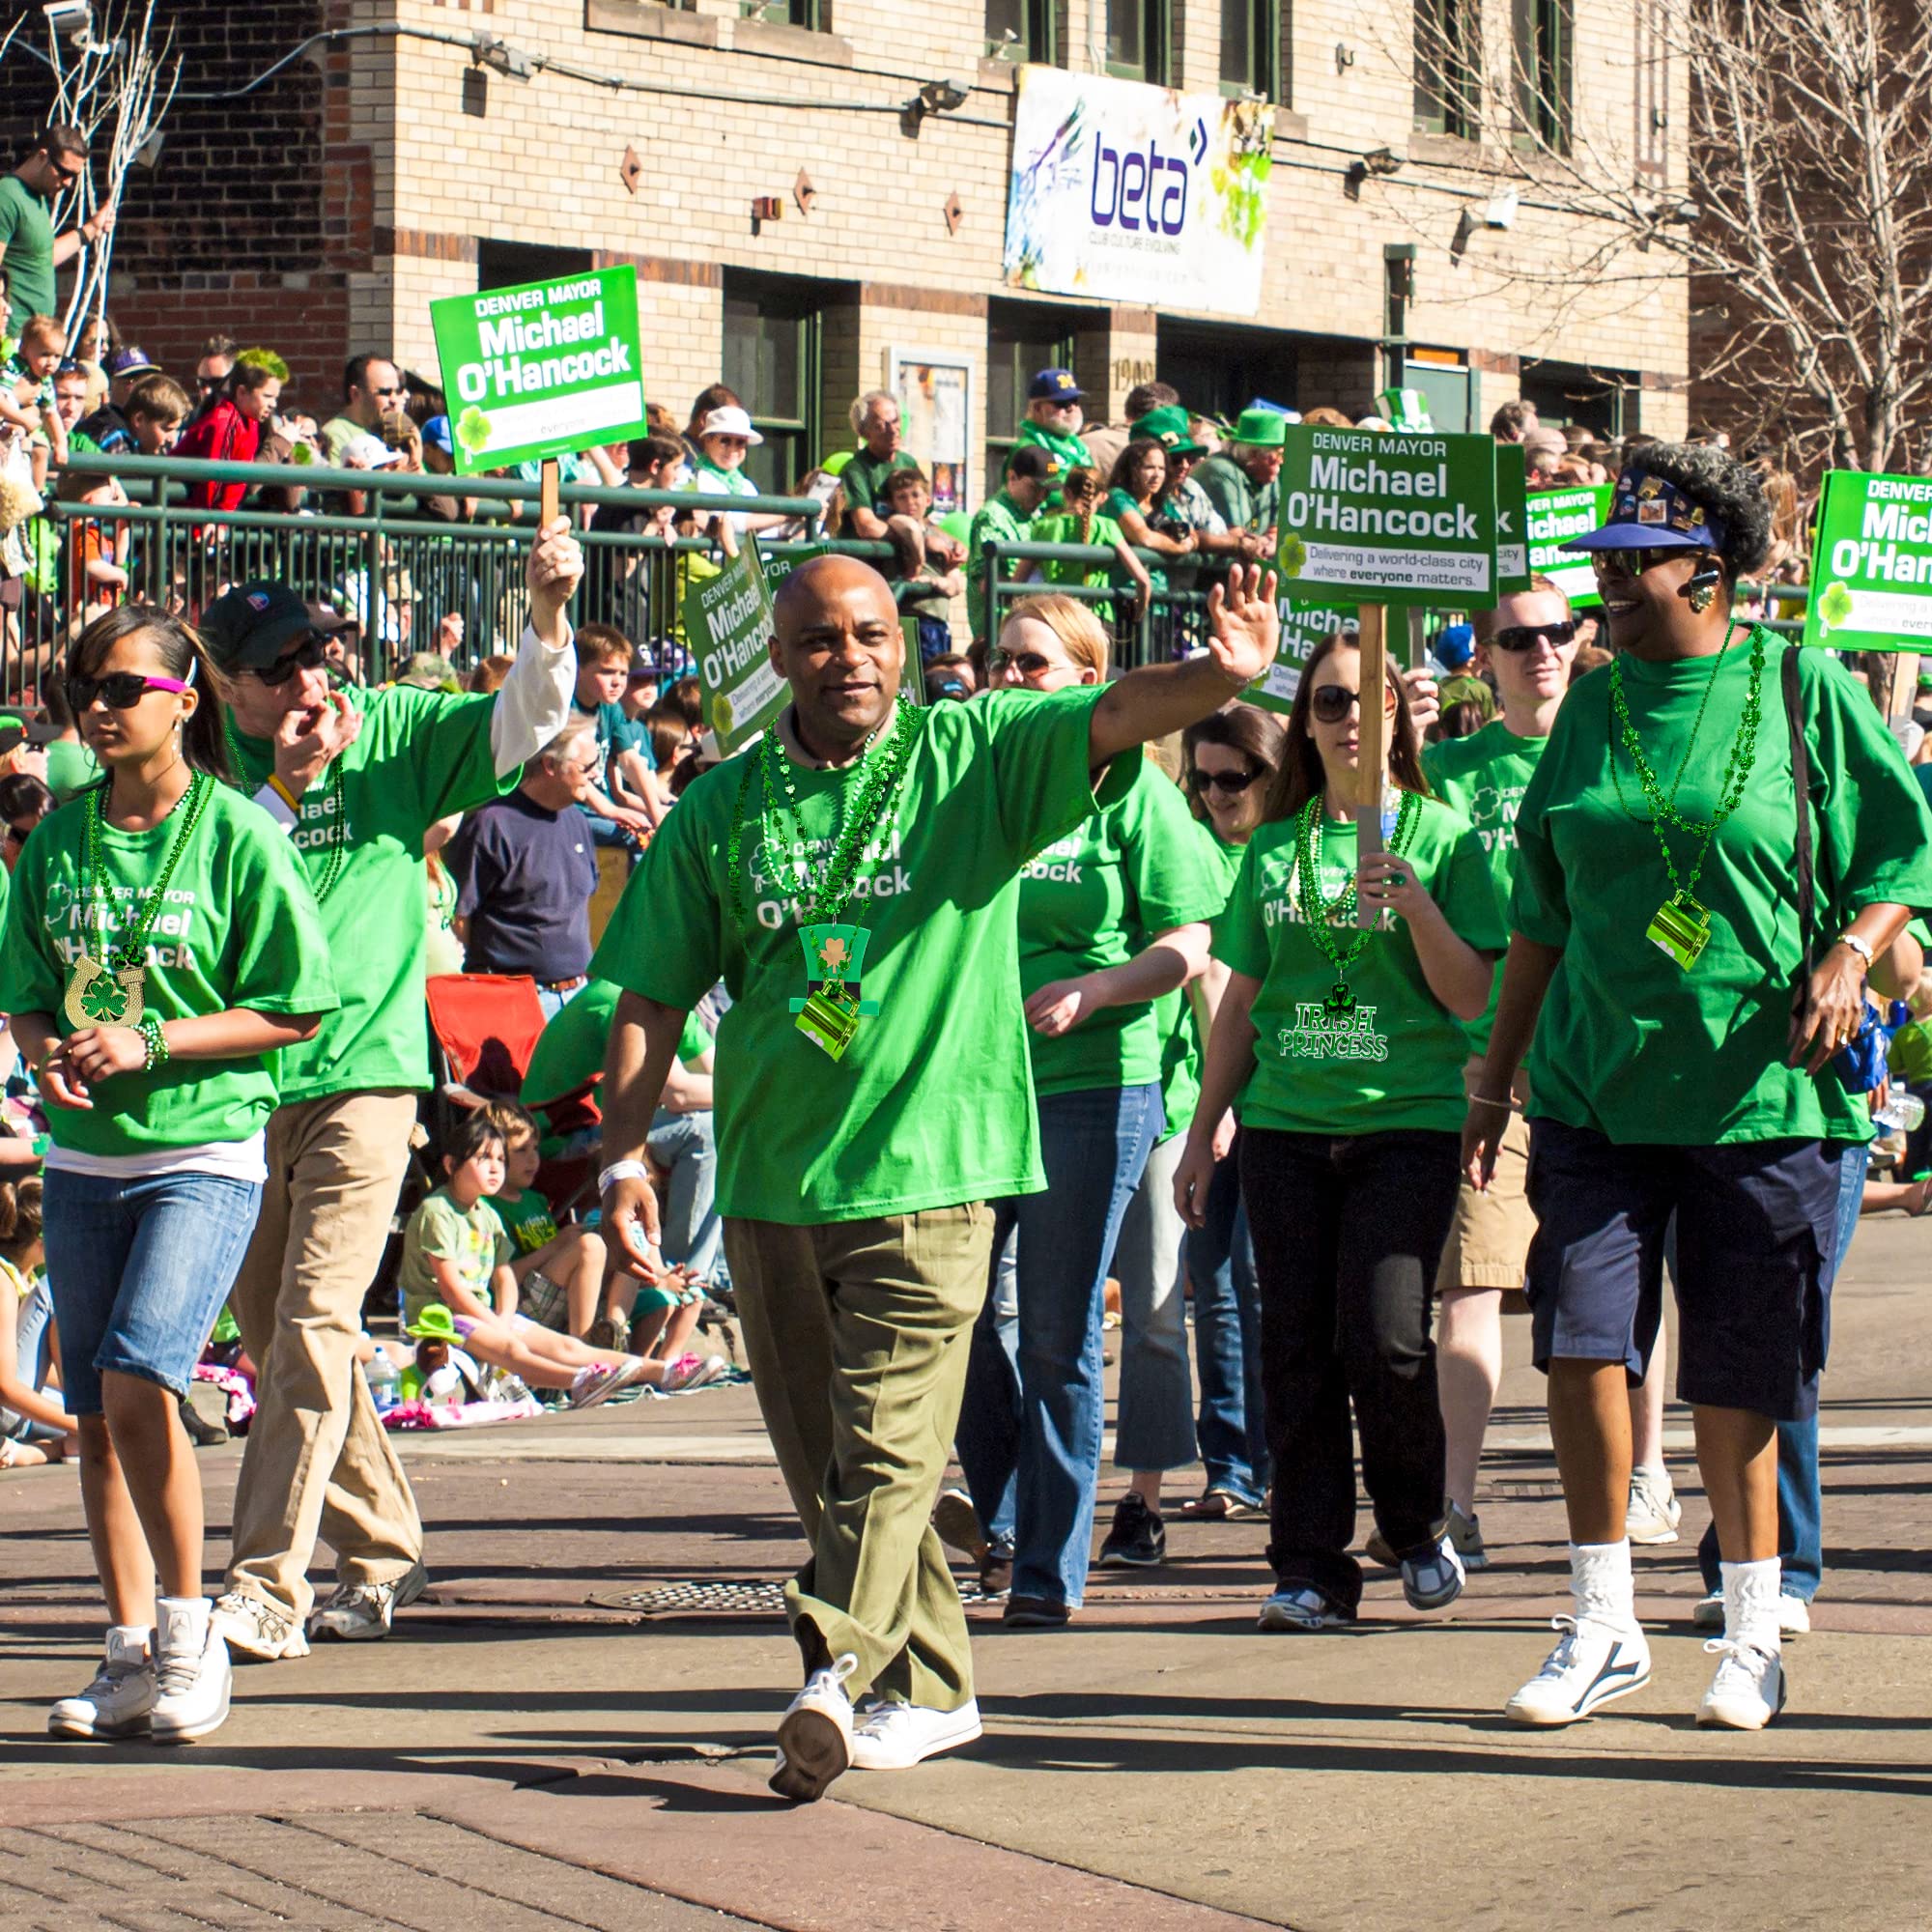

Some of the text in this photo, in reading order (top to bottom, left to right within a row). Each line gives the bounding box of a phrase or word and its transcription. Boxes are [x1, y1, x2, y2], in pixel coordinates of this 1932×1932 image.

[1092, 131, 1188, 236] beta
[474, 278, 602, 318] DENVER MAYOR
[478, 300, 605, 357] Michael
[457, 336, 632, 402] O'Hancock
[1312, 433, 1447, 457] DENVER MAYOR
[1310, 455, 1448, 497] Michael
[1288, 492, 1479, 540] O'Hancock
[1552, 492, 1596, 509] MAYOR
[1861, 502, 1932, 544] Mic
[1310, 546, 1484, 573] Delivering a world-class city
[1313, 564, 1477, 586] where everyone matters.
[1294, 1003, 1378, 1036] IRISH
[1277, 1029, 1389, 1062] PRINCESS
